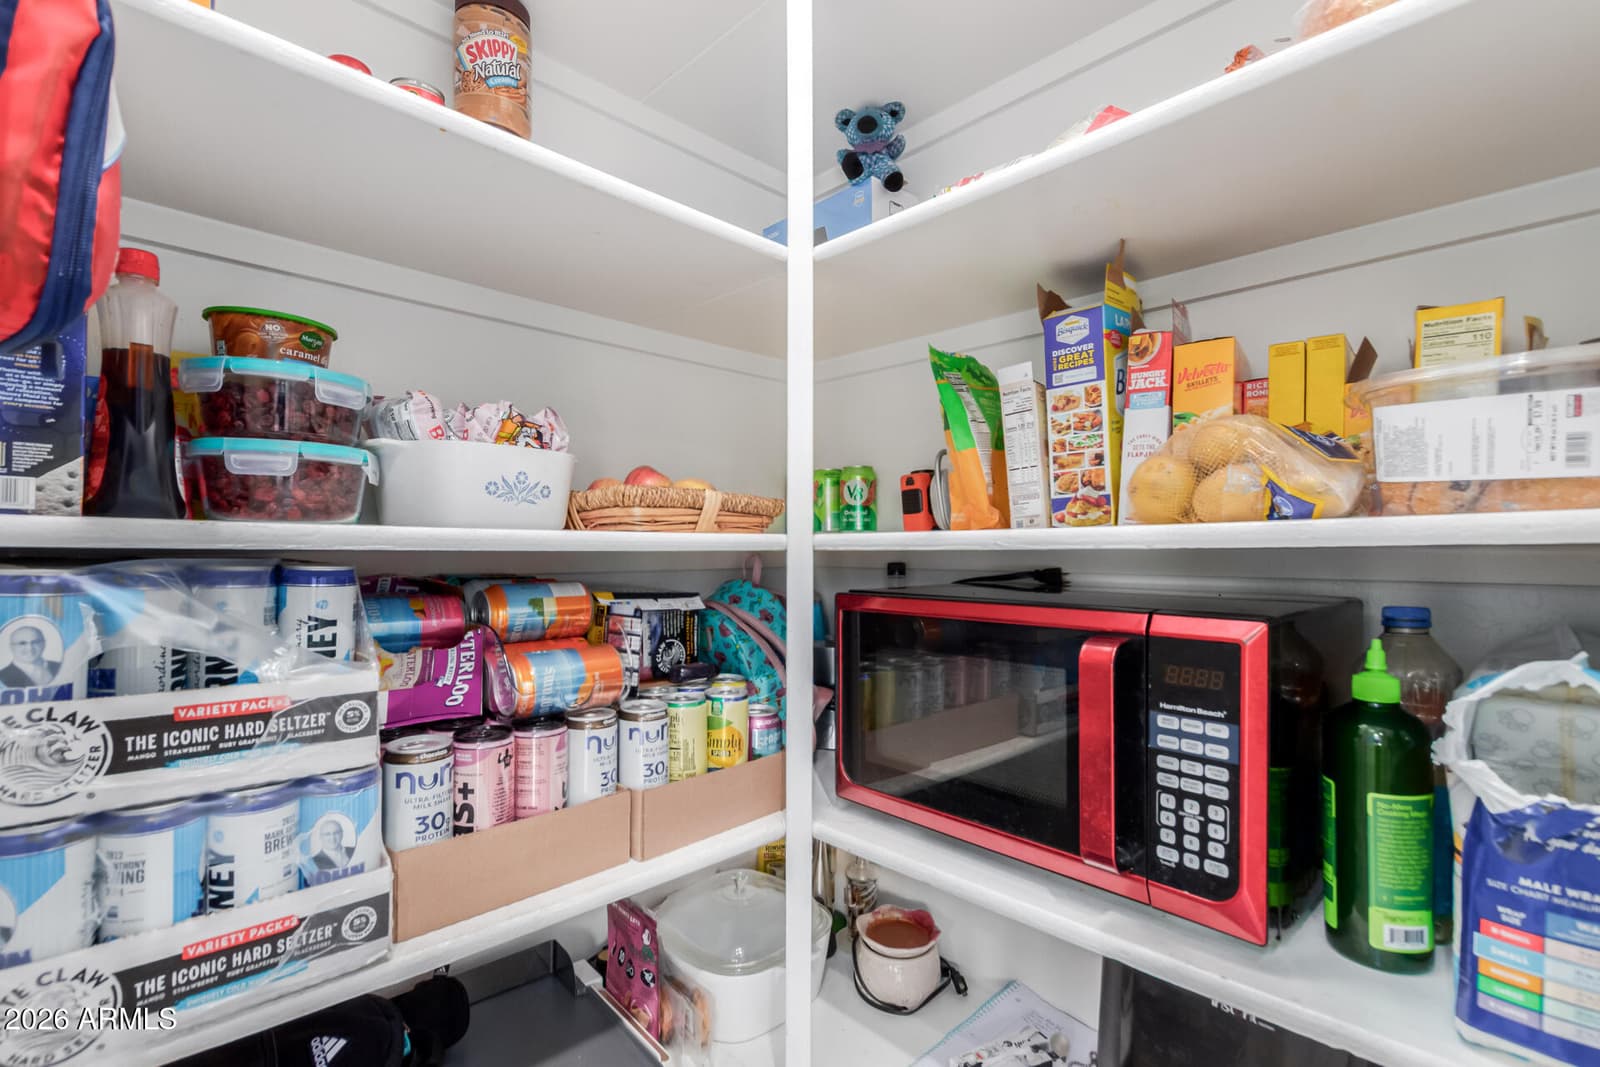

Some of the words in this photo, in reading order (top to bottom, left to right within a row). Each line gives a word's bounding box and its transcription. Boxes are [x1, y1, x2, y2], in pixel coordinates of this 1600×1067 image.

[465, 38, 516, 64] SKIPPY
[472, 59, 521, 82] Natural
[279, 346, 320, 363] caramel
[1052, 342, 1095, 358] DISCOVER
[1059, 349, 1095, 364] GREAT
[1058, 357, 1095, 371] RECIPES
[1176, 361, 1232, 385] Velveeta
[1129, 377, 1168, 390] JACK
[1131, 369, 1168, 380] HUNGRY
[847, 483, 864, 501] V8
[177, 701, 237, 719] VARIETY
[1159, 701, 1197, 714] Hamilton
[25, 706, 101, 735] CLAW
[124, 733, 158, 753] THE
[162, 725, 220, 749] ICONIC
[224, 720, 265, 740] HARD
[270, 712, 327, 733] SELTZER
[127, 751, 157, 761] MANGO
[163, 744, 211, 757] STRAWBERRY
[1518, 876, 1562, 896] MALE
[1564, 887, 1600, 905] WRA
[186, 931, 246, 957] VARIETY
[36, 966, 110, 990] CLAW
[133, 974, 167, 999] THE
[171, 955, 228, 988] ICONIC
[232, 942, 272, 969] HARD
